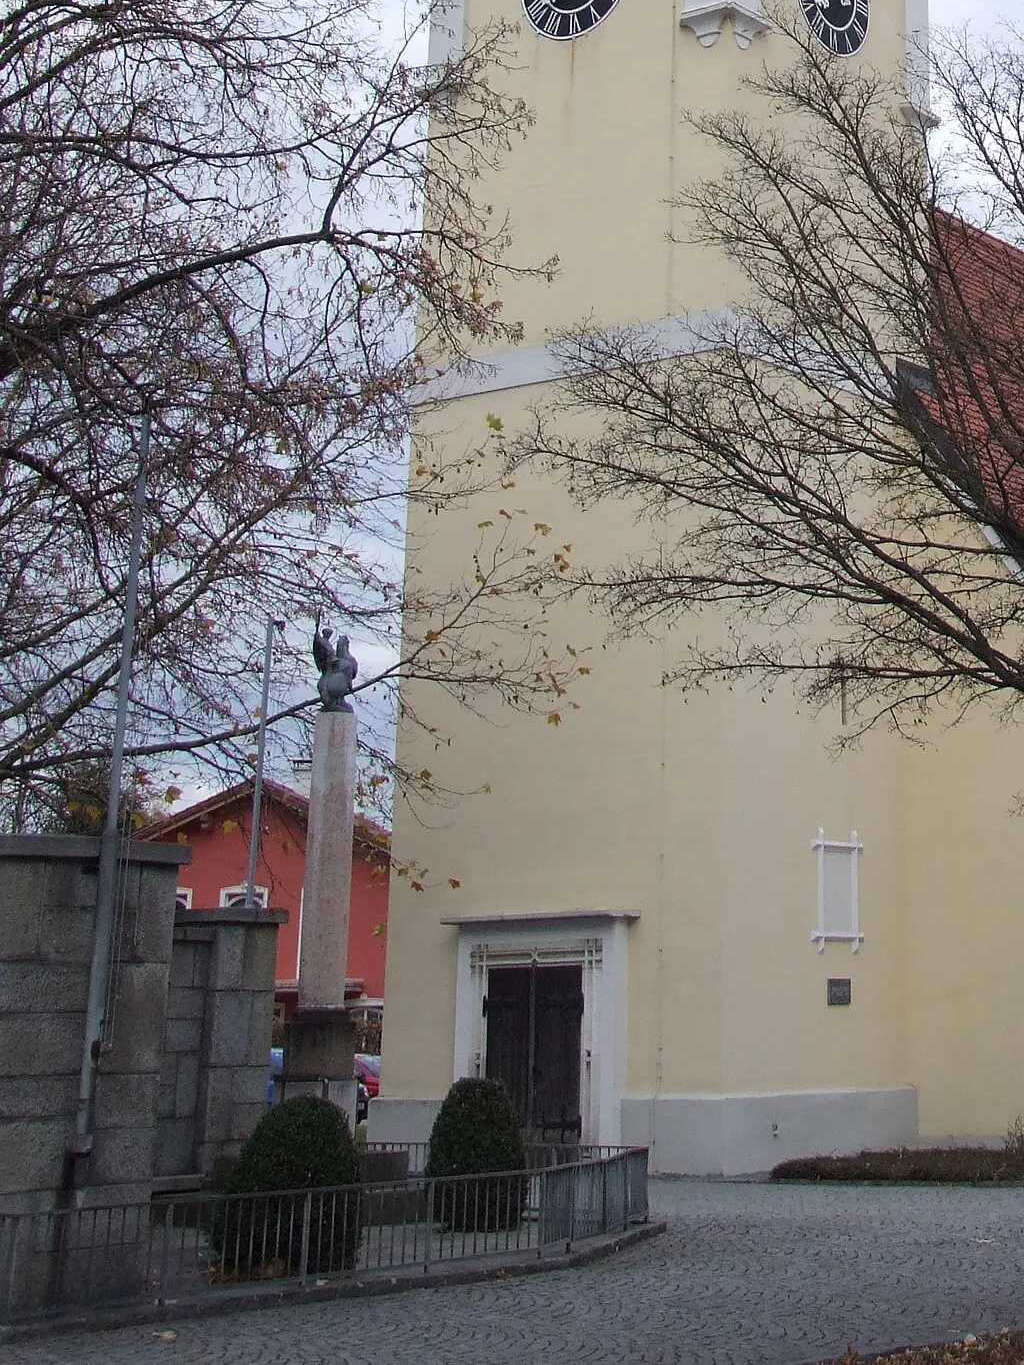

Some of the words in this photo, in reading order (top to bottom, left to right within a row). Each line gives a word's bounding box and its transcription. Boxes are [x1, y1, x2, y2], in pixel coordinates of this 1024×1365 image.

[543, 11, 561, 35] VII
[568, 13, 582, 35] VI
[589, 4, 602, 24] V
[844, 31, 853, 54] V
